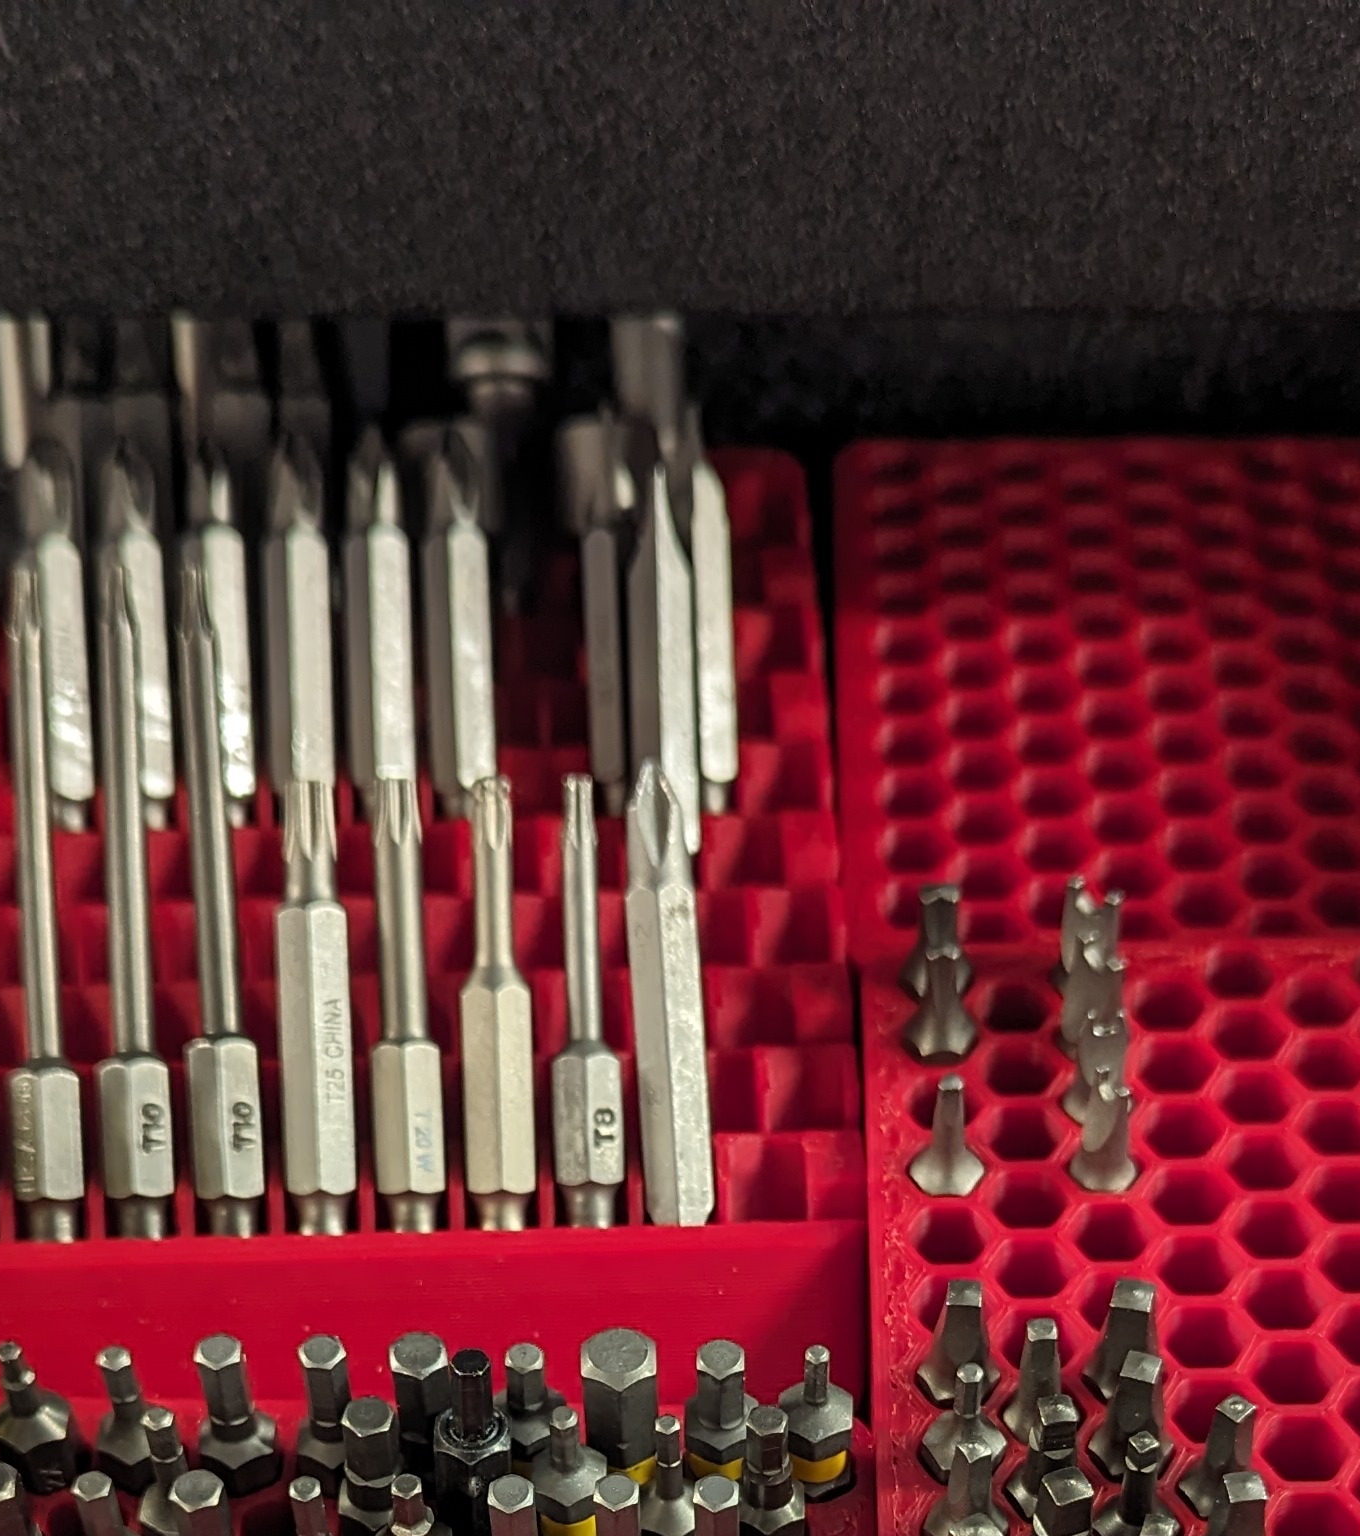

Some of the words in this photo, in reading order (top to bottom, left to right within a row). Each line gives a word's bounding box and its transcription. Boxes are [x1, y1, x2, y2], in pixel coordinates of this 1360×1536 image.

[320, 998, 345, 1059] CHINA
[324, 1067, 346, 1105] T25
[141, 1103, 166, 1155] T10
[231, 1102, 256, 1155] T10
[592, 1107, 617, 1149] T8
